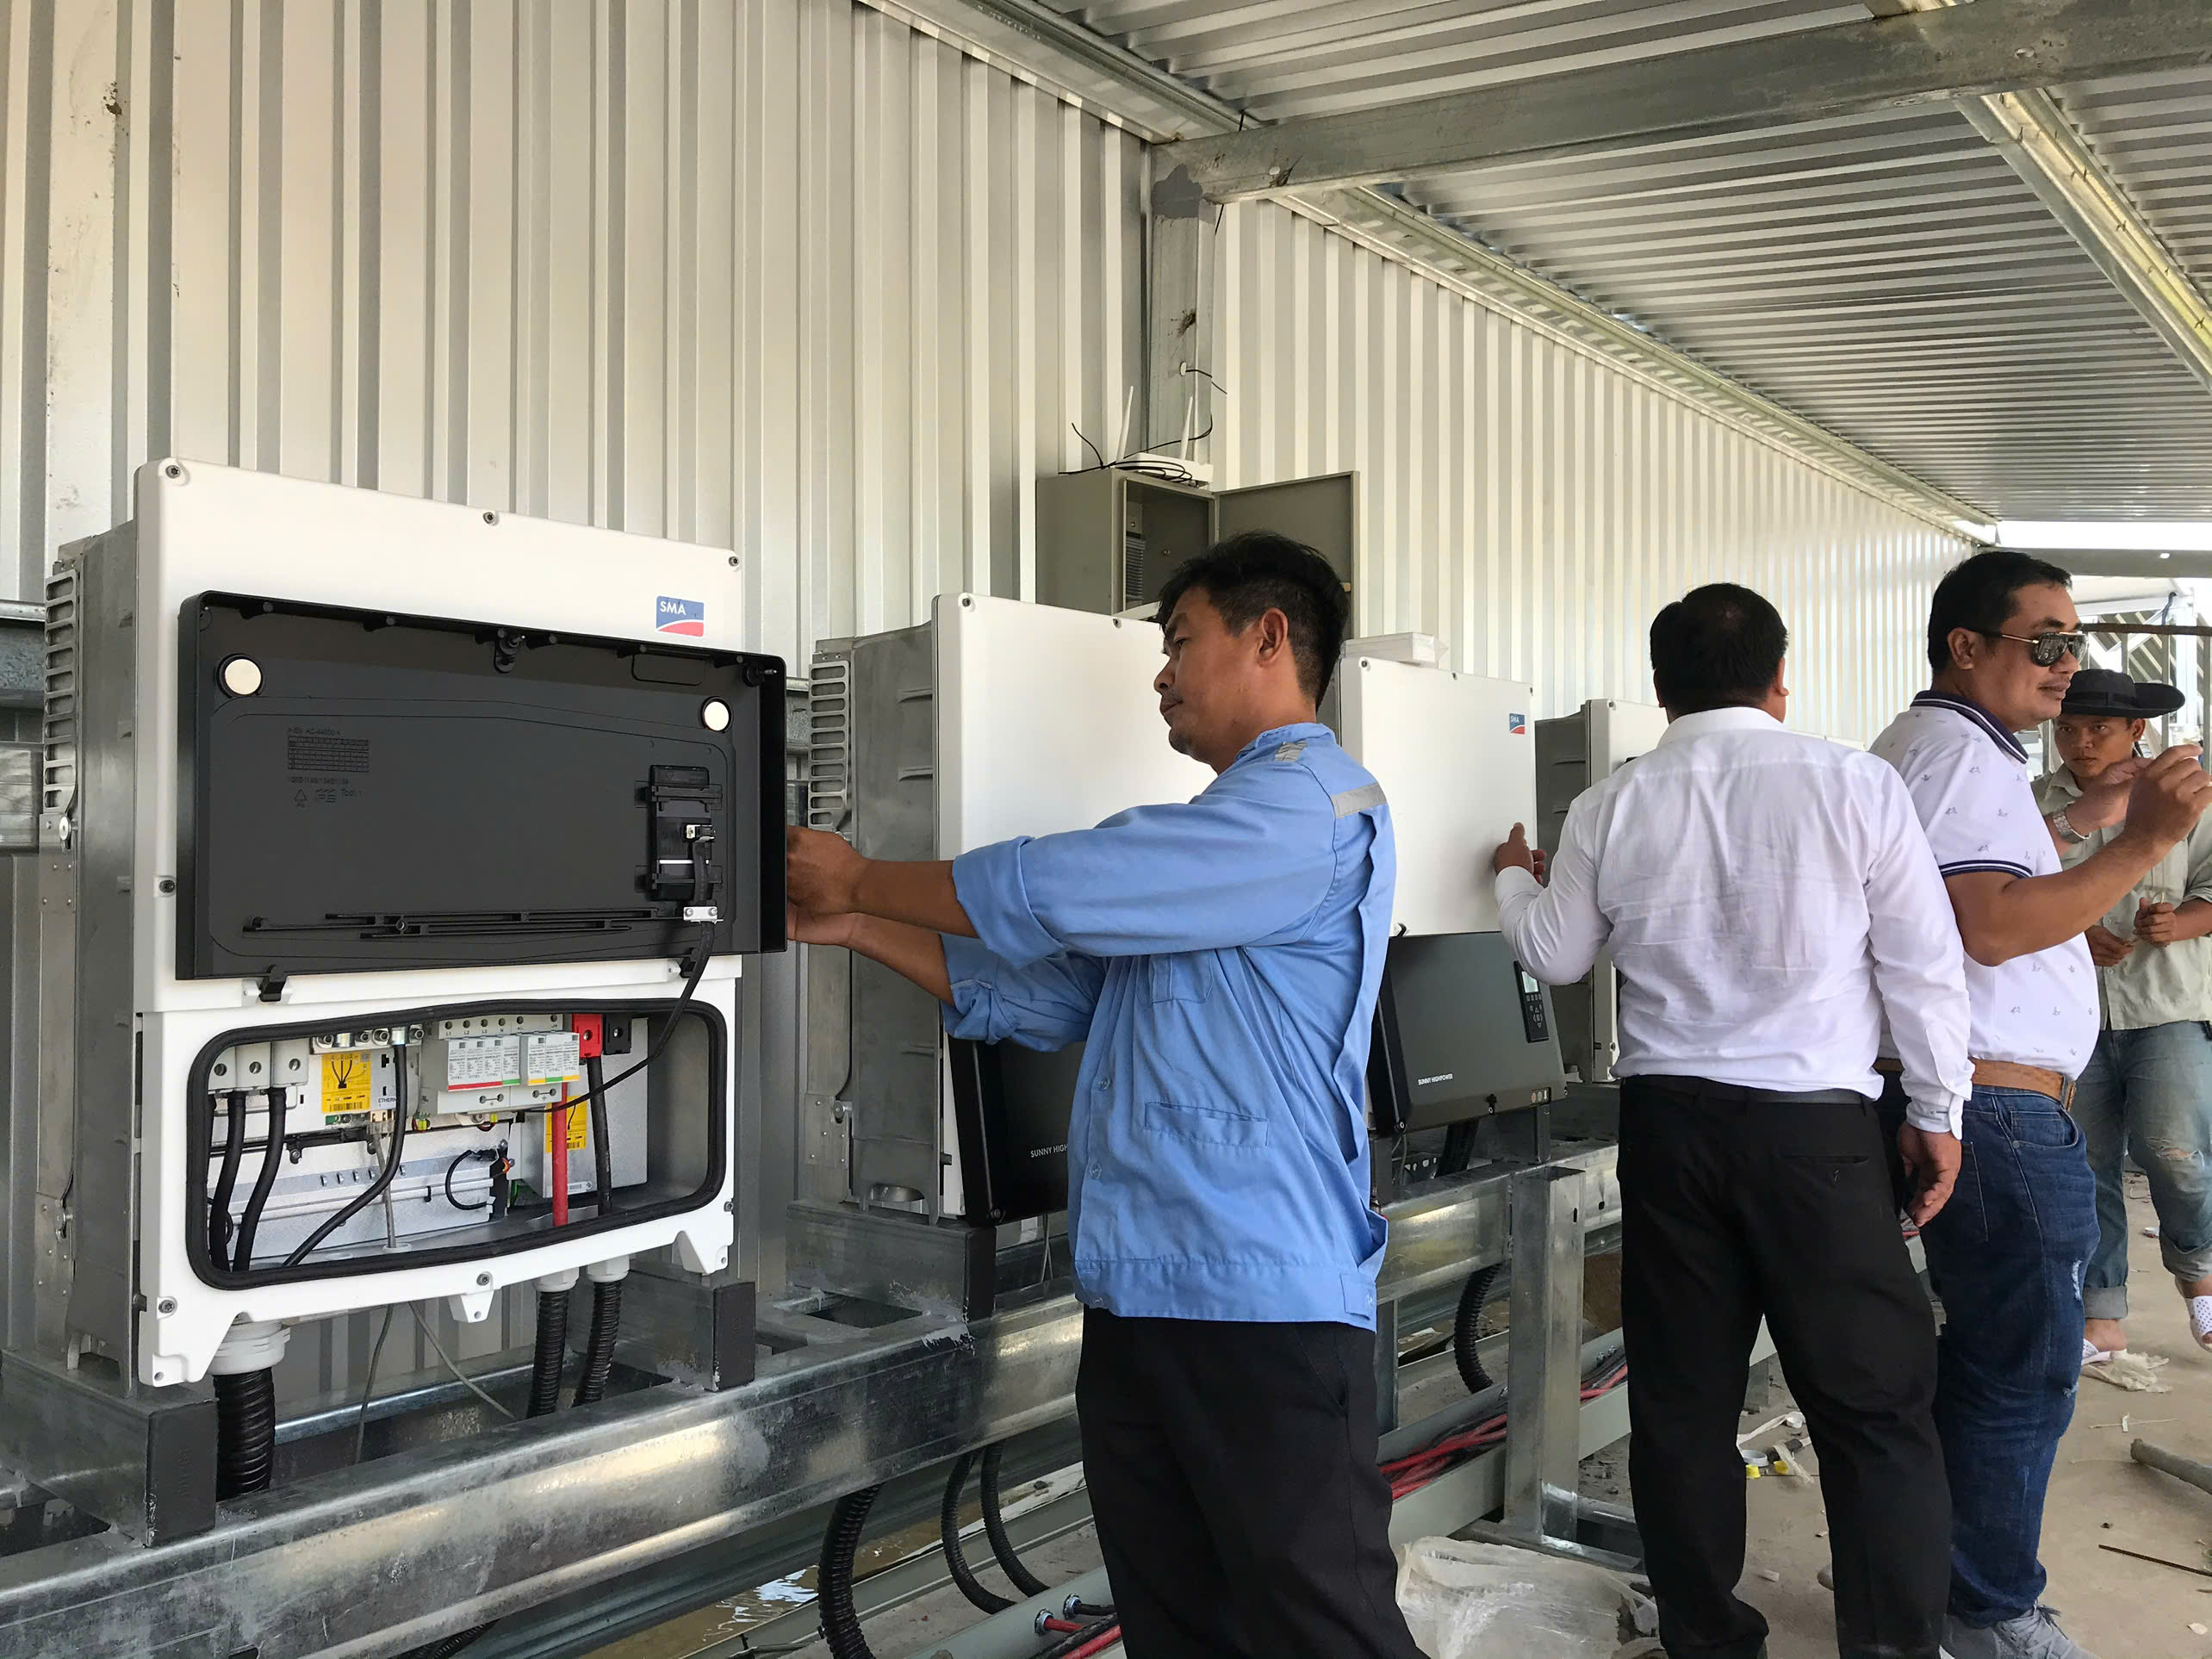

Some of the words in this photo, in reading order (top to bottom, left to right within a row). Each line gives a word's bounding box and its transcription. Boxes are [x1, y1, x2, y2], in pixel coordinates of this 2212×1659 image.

[660, 600, 687, 616] SMA
[1510, 715, 1519, 724] SMA
[1418, 1077, 1432, 1085] SUNNY
[1432, 1073, 1453, 1083] HIGHPOWER
[1030, 1146, 1052, 1158] SUNNY
